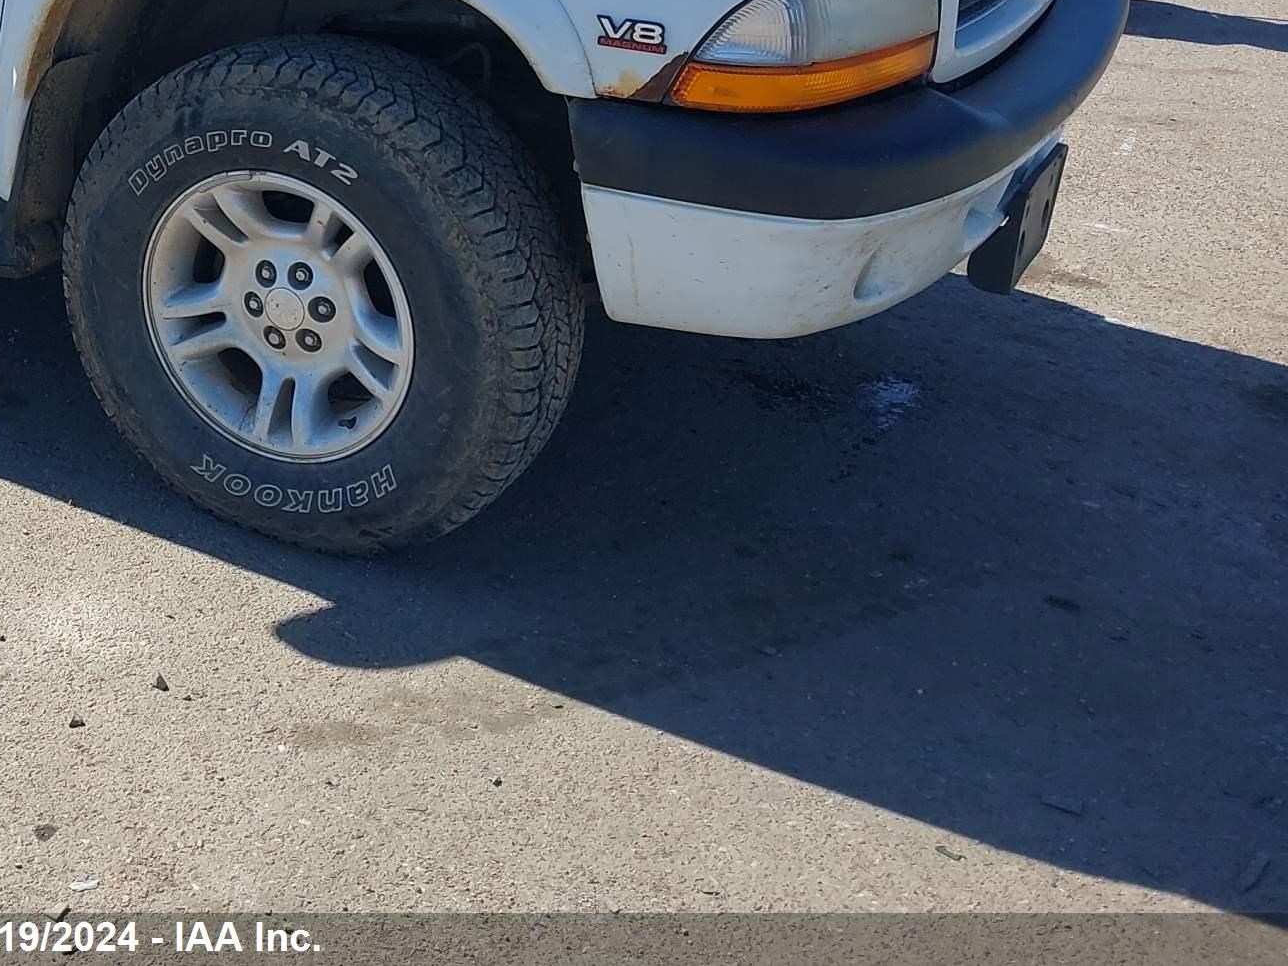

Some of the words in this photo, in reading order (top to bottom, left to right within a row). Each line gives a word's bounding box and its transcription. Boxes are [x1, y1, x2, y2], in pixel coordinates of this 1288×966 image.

[597, 15, 665, 45] V8
[598, 37, 665, 54] MAGNUM
[128, 129, 273, 196] Dynapro
